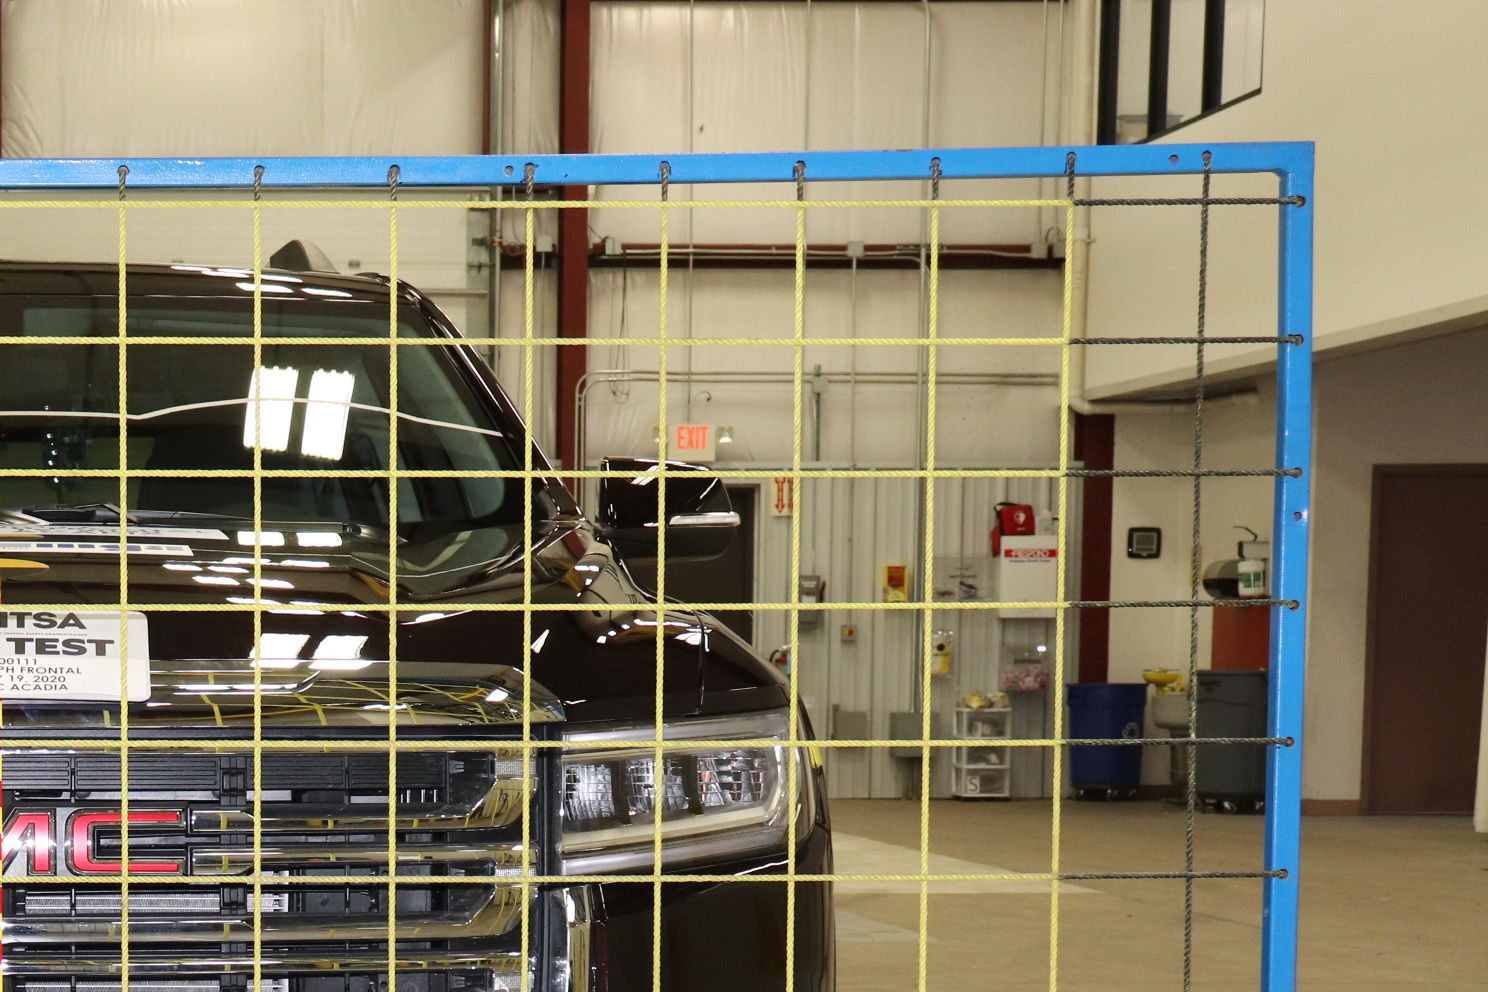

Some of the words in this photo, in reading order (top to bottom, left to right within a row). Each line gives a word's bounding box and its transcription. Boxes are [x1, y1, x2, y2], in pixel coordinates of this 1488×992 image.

[677, 425, 709, 449] EXIT
[6, 638, 115, 656] TEST
[10, 675, 27, 683] 19,
